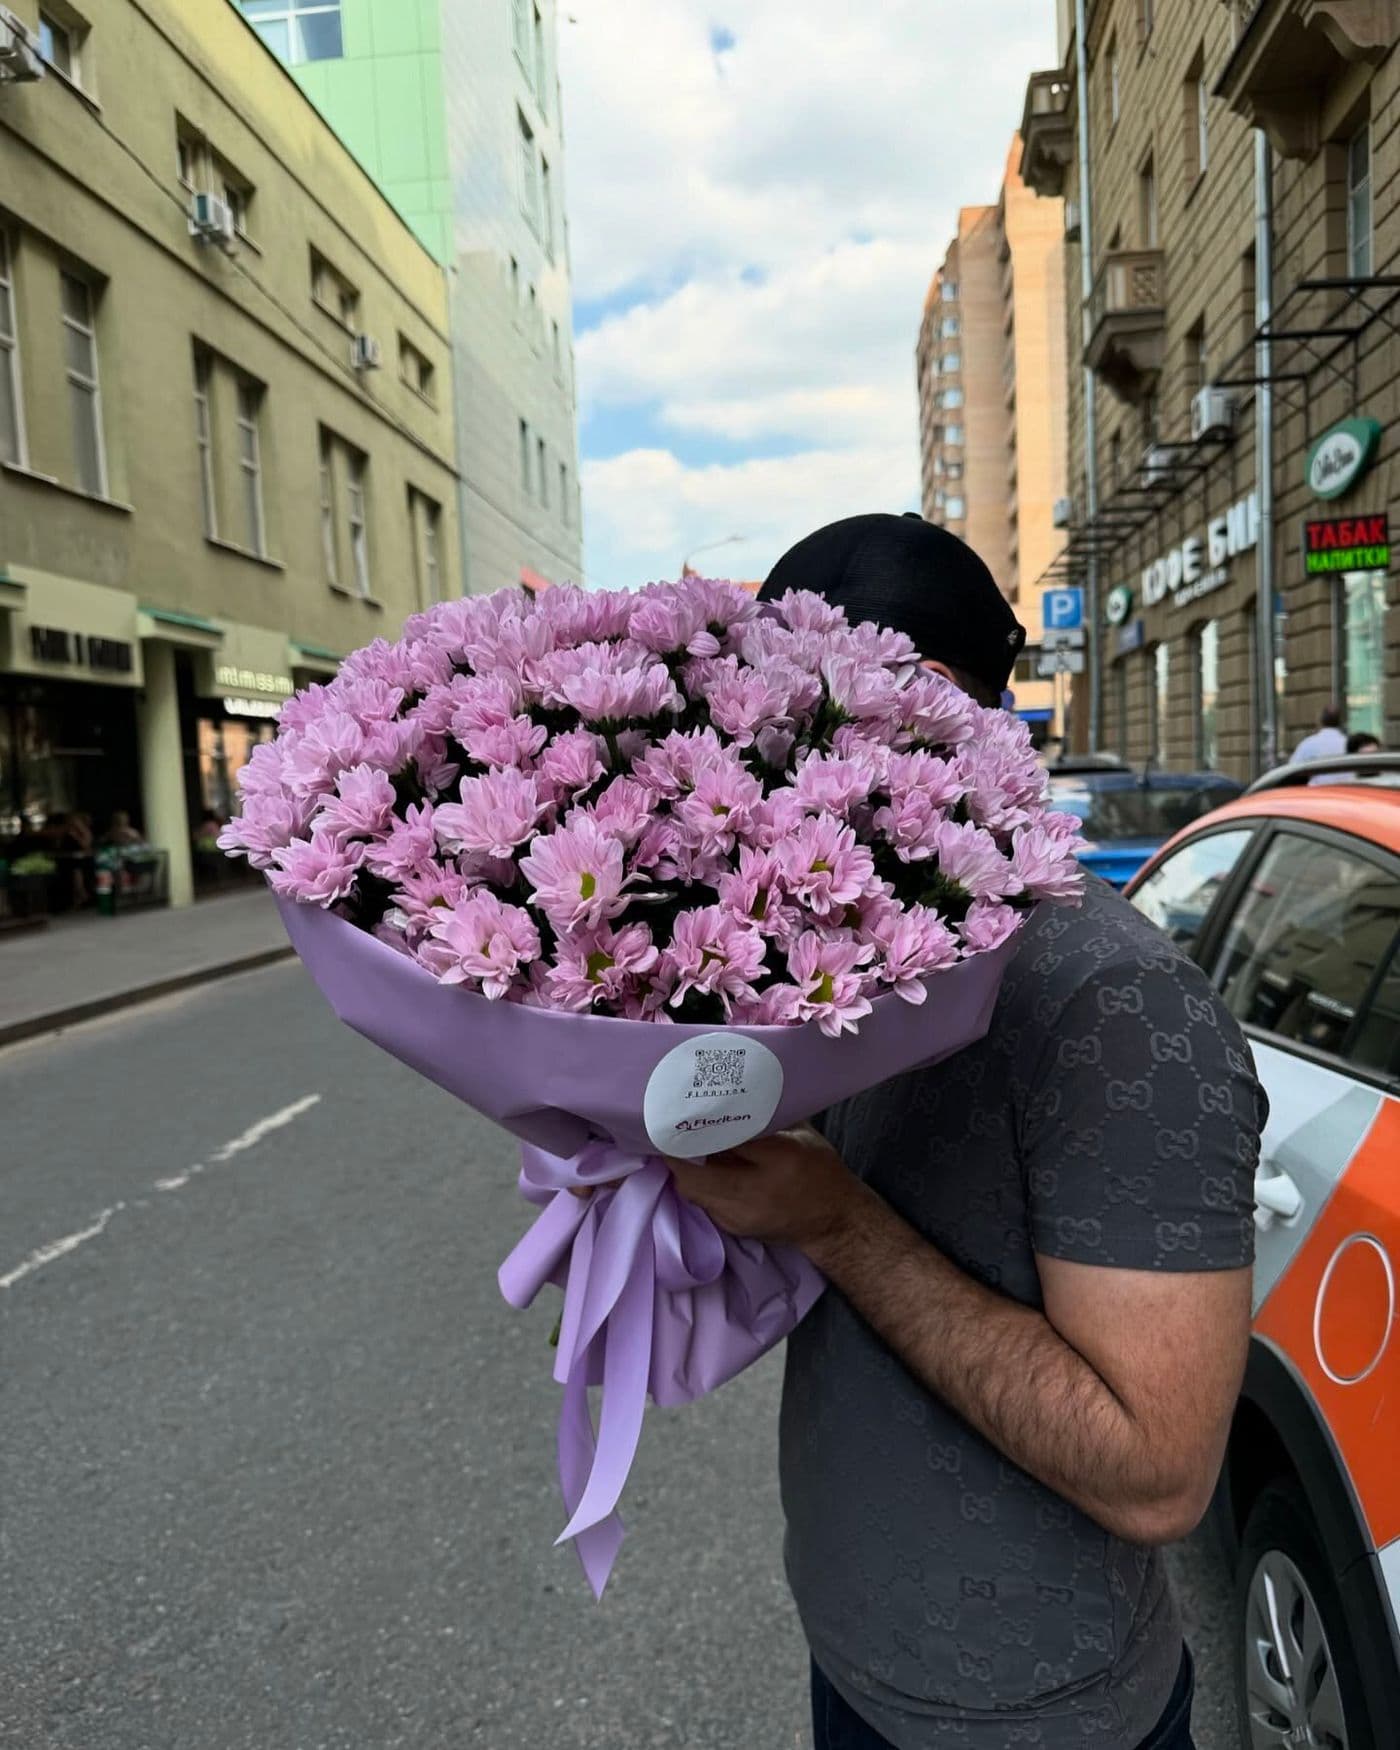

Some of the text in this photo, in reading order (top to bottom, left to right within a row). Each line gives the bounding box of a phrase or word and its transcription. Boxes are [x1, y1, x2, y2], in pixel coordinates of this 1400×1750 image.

[1308, 518, 1385, 549] ТАБАК
[1306, 545, 1390, 573] НАПИТКИ
[1051, 592, 1075, 625] P
